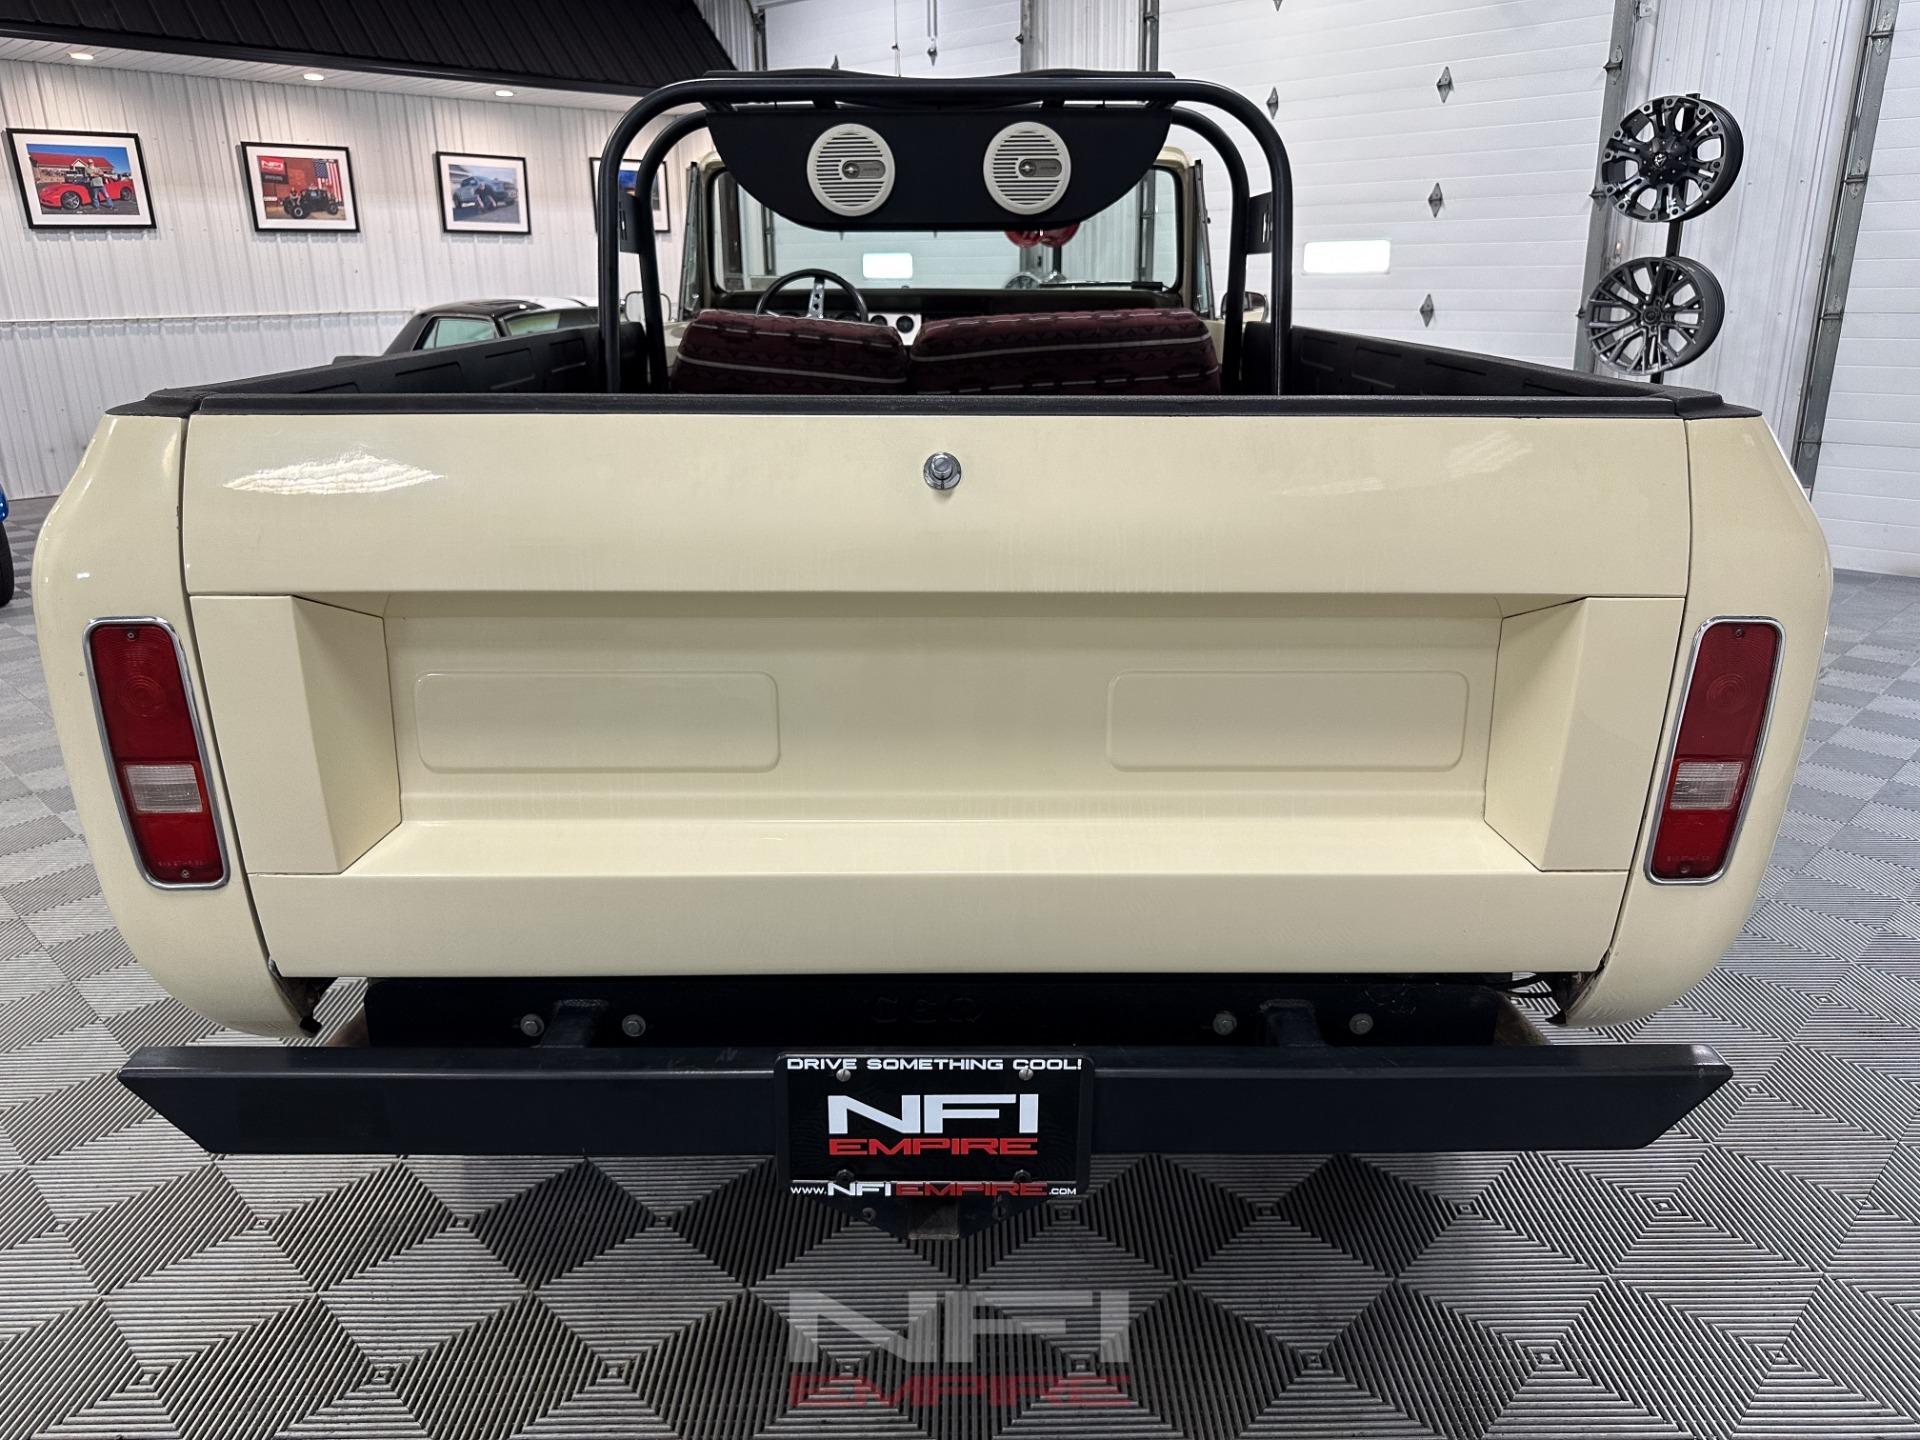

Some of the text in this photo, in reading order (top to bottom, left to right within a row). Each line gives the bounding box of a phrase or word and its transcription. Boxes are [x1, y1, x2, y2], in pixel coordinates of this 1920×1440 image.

[787, 1058, 1082, 1071] DRIVE SOMETHING COOL!
[827, 1093, 1039, 1135] NFI
[829, 1138, 1039, 1156] EMPIRE
